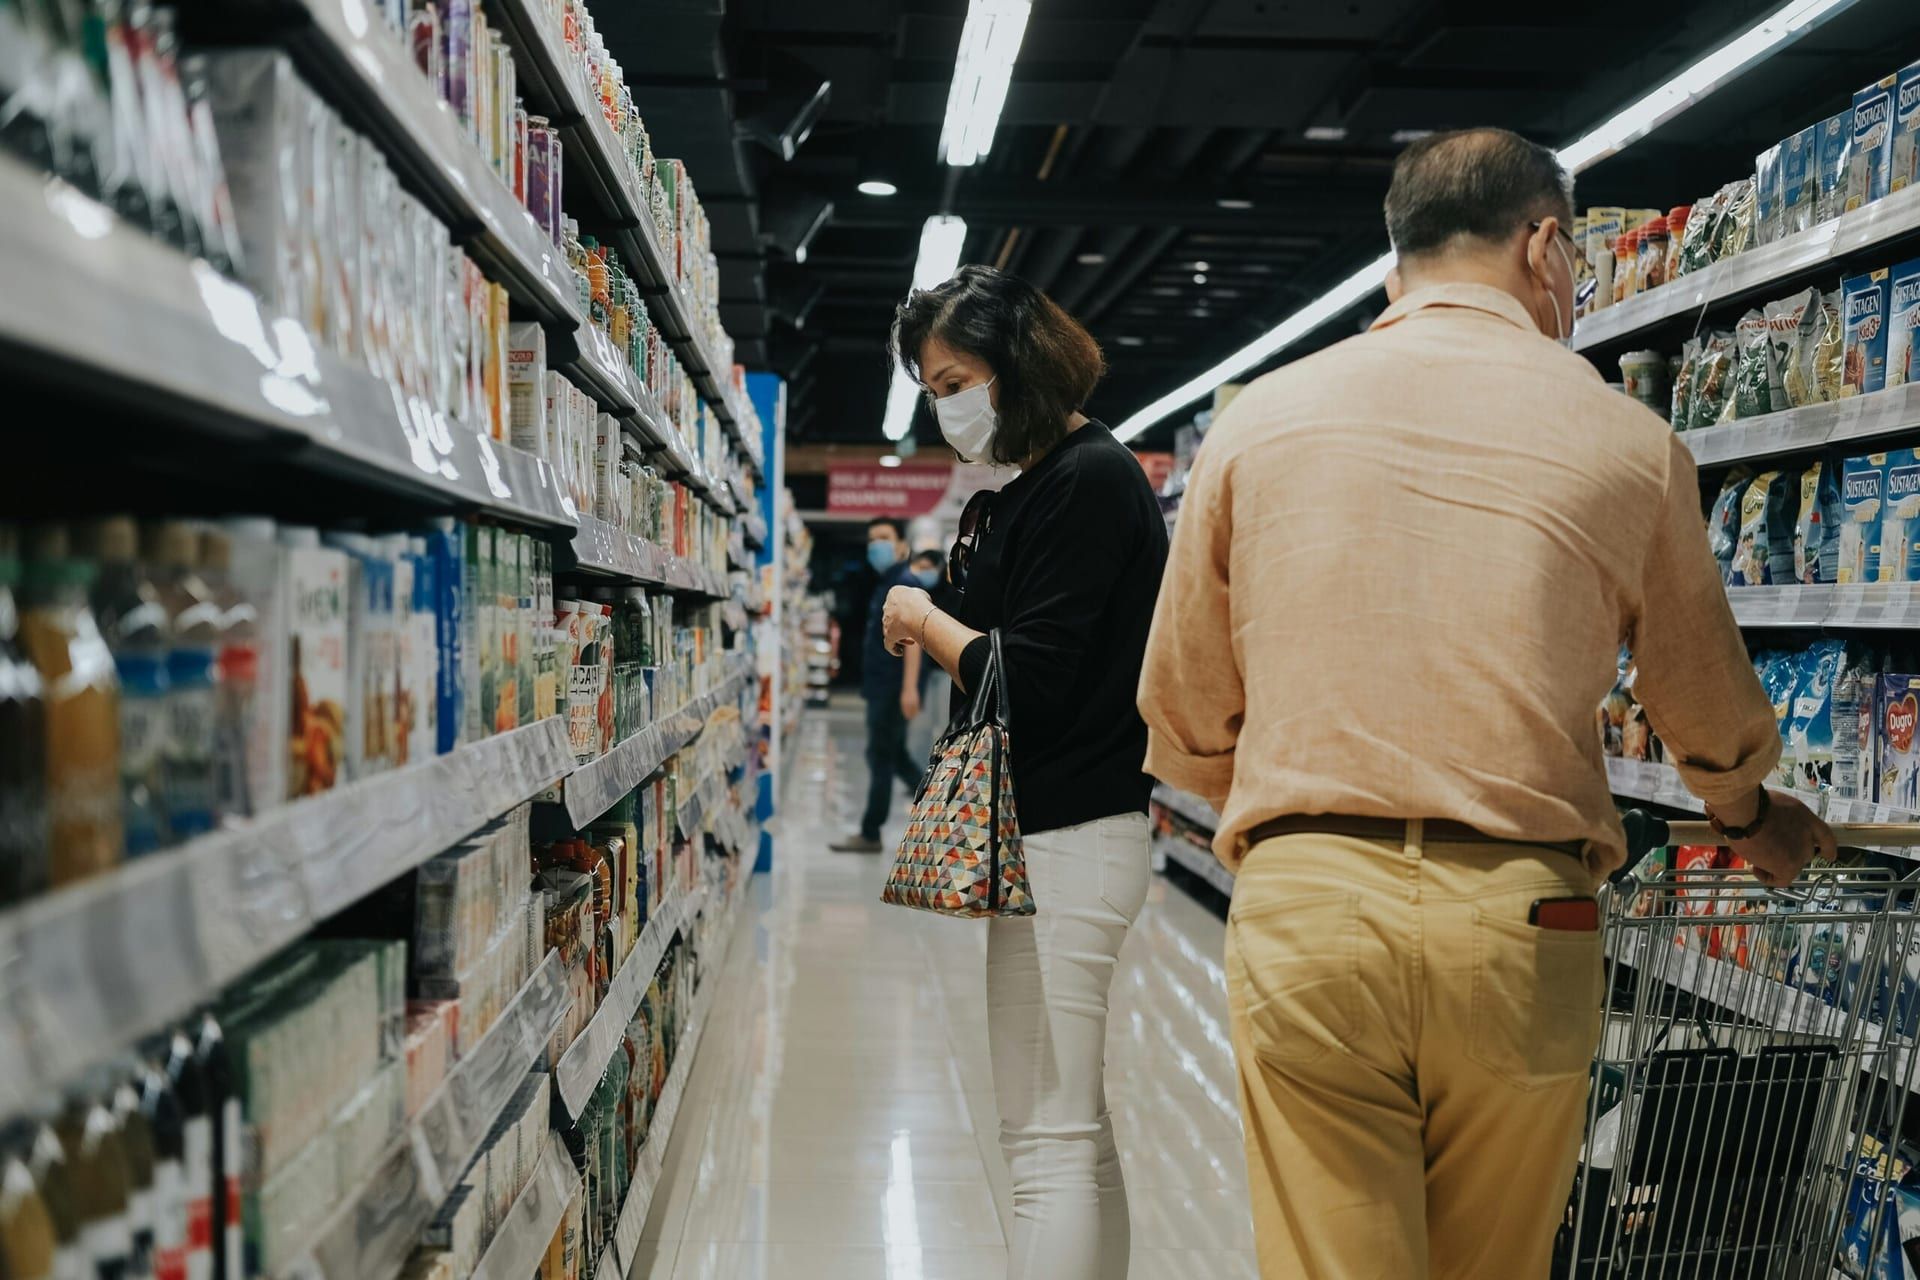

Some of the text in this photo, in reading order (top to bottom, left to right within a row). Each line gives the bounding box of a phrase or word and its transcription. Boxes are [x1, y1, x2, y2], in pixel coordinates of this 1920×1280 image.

[1900, 85, 1920, 108] SUSTA
[1855, 101, 1887, 130] SUSTAGEN
[1846, 478, 1879, 499] SUSTAGEN
[1890, 712, 1912, 732] Dugro
